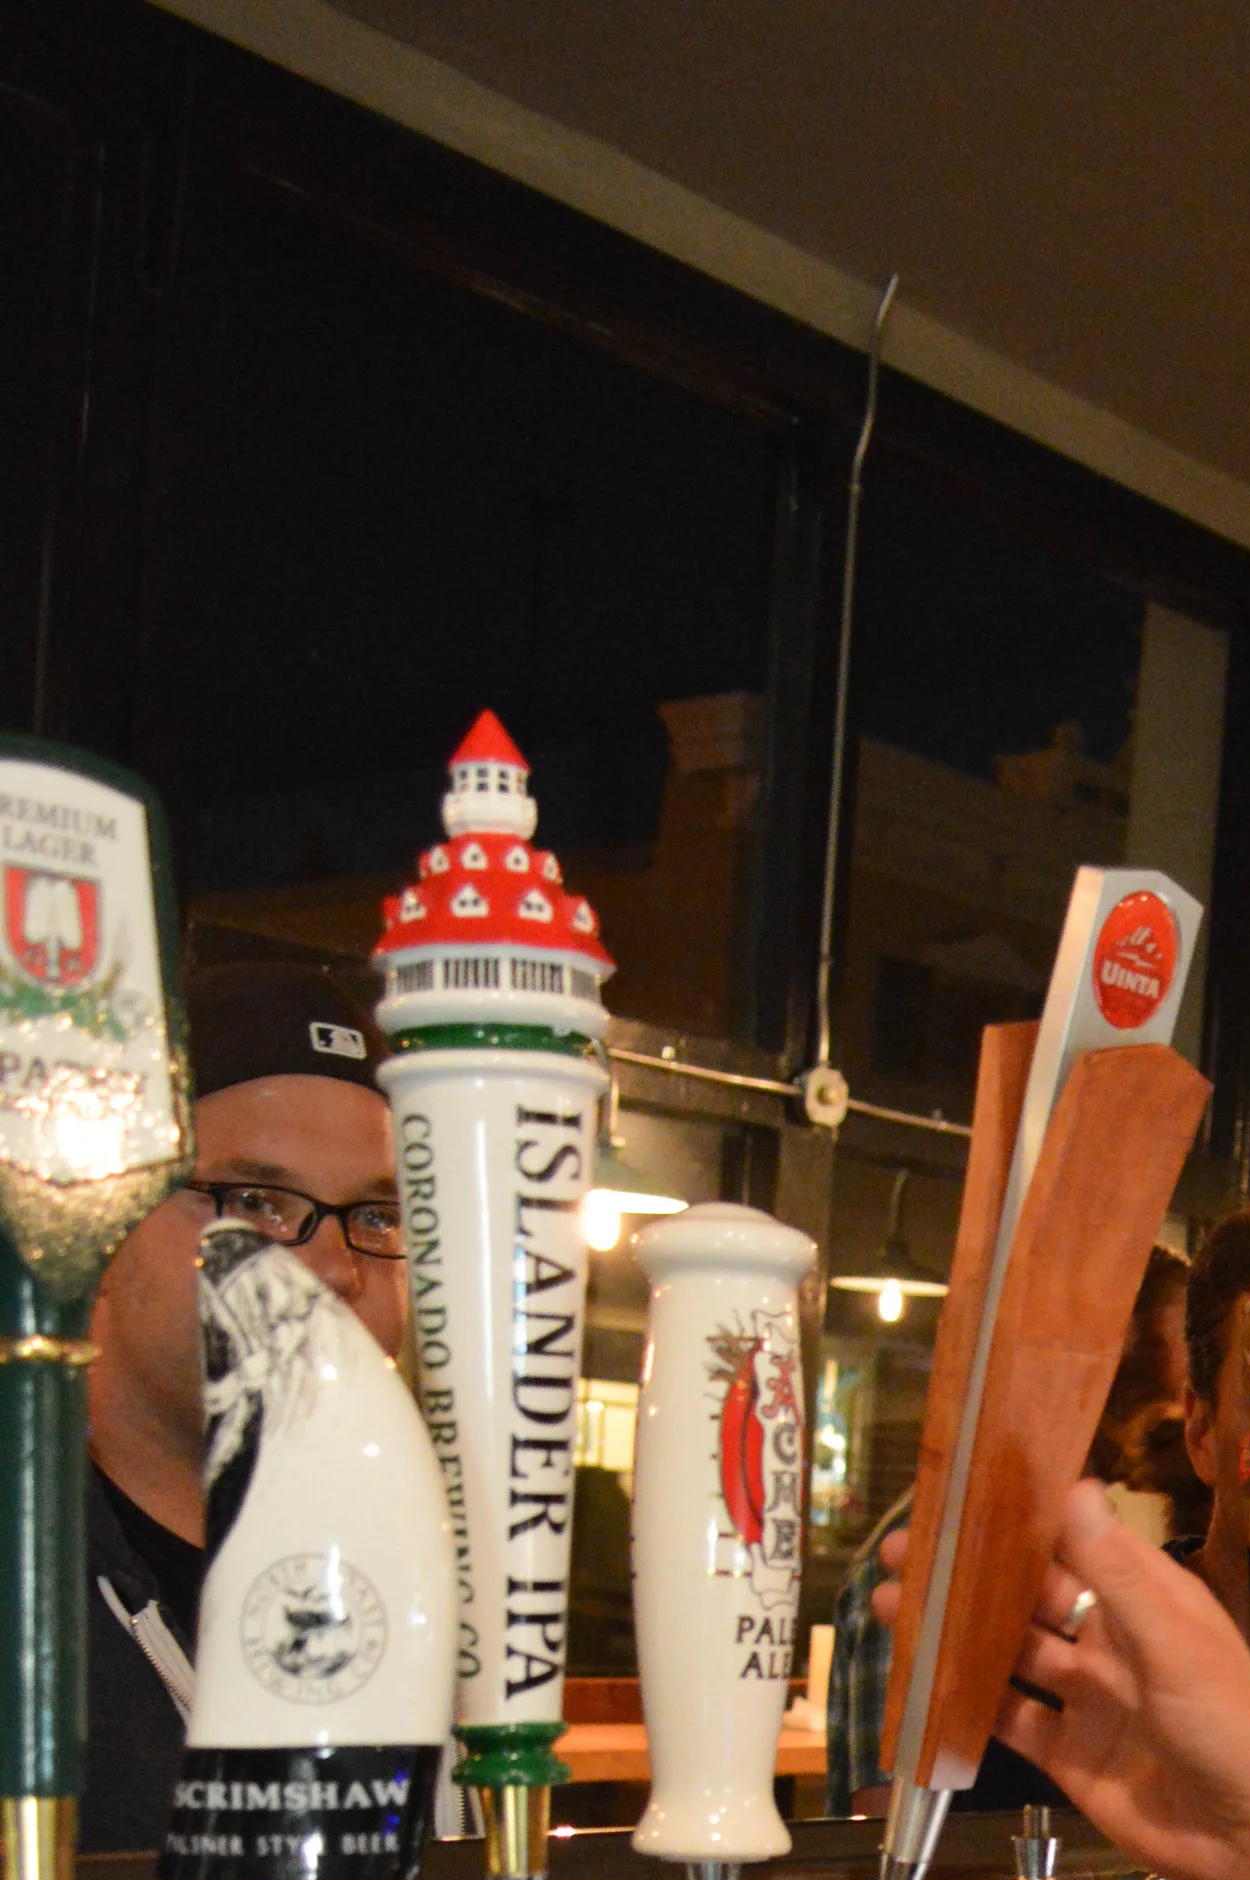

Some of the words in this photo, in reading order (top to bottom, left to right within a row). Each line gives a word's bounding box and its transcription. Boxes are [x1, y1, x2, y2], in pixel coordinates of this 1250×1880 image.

[0, 792, 118, 840] REMIUM
[3, 832, 98, 868] LAGER
[1102, 959, 1161, 1001] UINTA
[401, 1112, 452, 1370] CORONADO
[508, 1103, 583, 1542] ISLANDER
[504, 1575, 567, 1701] IPA
[740, 1650, 793, 1679] ALE
[174, 1779, 411, 1811] SCRIMSHAW
[256, 1832, 326, 1857] STY
[341, 1832, 400, 1857] BEER
